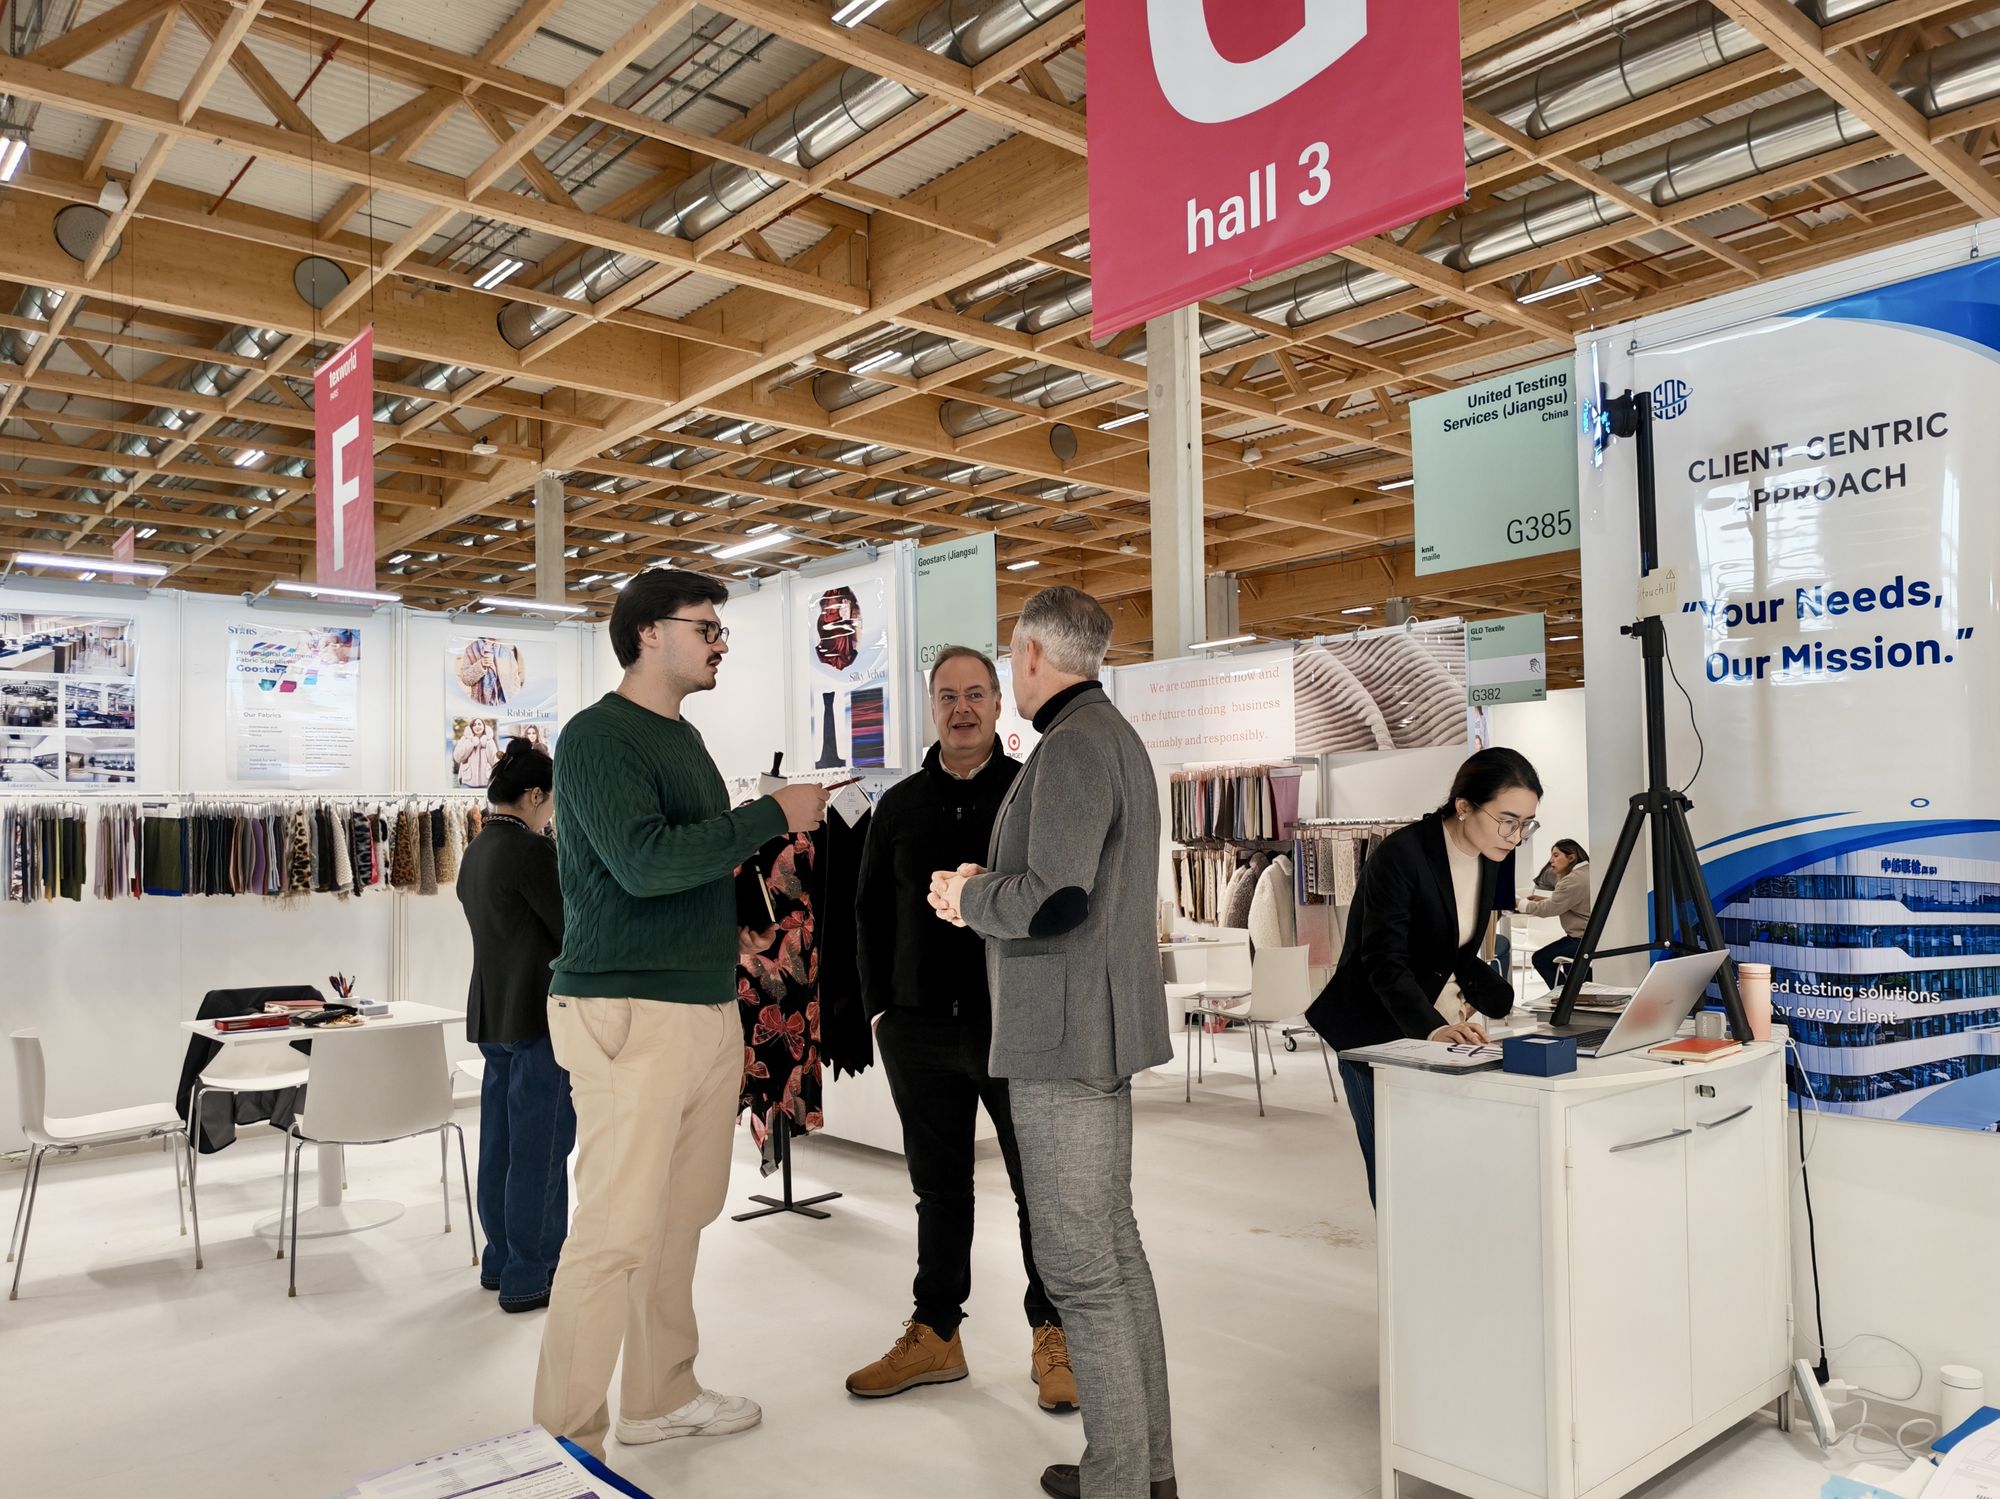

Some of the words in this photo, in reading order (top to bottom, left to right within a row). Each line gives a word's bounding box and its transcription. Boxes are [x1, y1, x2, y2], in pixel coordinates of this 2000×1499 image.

[1187, 162, 1277, 255] hall
[1298, 141, 1331, 206] 3
[329, 348, 357, 388] texworld
[1467, 385, 1512, 409] United
[1515, 373, 1567, 396] Testing
[1443, 410, 1499, 433] Services
[1503, 389, 1568, 419] (Jiangsu)
[1542, 409, 1569, 422] China
[332, 414, 360, 572] F
[1736, 463, 1906, 512] PPROACH
[1506, 509, 1572, 544] G385
[918, 553, 946, 567] Goostars
[947, 545, 978, 561] (Jiangsu)
[1421, 545, 1434, 554] knit
[1421, 553, 1441, 562] maille
[1795, 575, 1943, 620] Needs,
[1470, 627, 1484, 635] GLO
[1485, 625, 1505, 633] Textile
[236, 664, 287, 674] Goostars
[1706, 652, 1771, 683] Our
[1149, 683, 1165, 694] We
[1166, 683, 1180, 692] are
[1180, 673, 1231, 690] committed
[1259, 667, 1280, 678] and
[1472, 687, 1501, 702] G382
[507, 708, 533, 717] Rabbit
[1130, 712, 1139, 723] in
[1141, 712, 1157, 722] the
[1158, 709, 1186, 721] future
[1187, 708, 1197, 717] to
[1199, 704, 1226, 717] doing
[1231, 698, 1280, 713] business
[1184, 733, 1202, 746] and
[1203, 729, 1267, 747] responsibly.
[1794, 981, 1854, 1001] testing
[1858, 985, 1940, 1004] solutions
[1797, 1007, 1842, 1024] every
[1847, 1008, 1897, 1025] client
